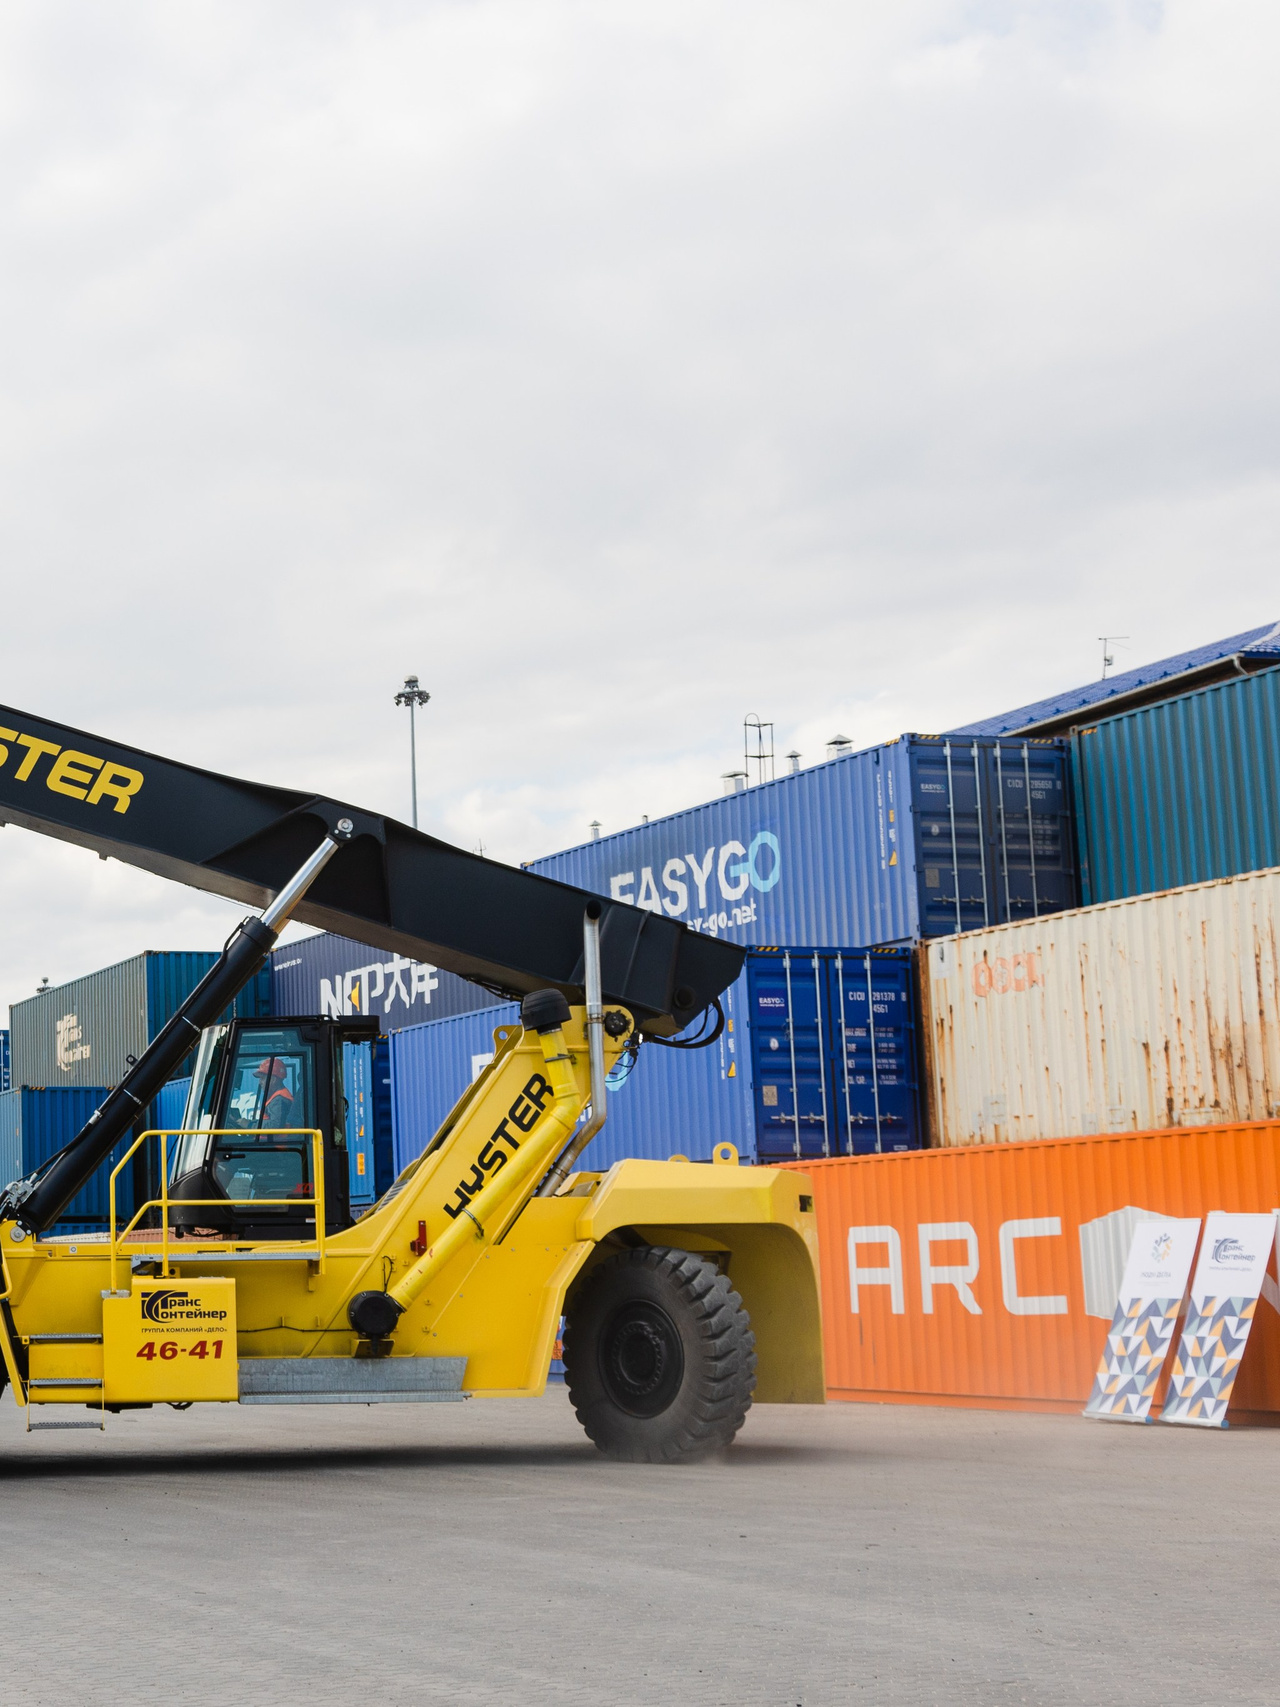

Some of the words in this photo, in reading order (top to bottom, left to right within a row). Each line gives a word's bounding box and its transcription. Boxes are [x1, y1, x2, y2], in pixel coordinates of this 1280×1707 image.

[610, 830, 780, 917] EASYGO
[848, 991, 865, 1001] CICU
[443, 1073, 554, 1219] HYSTER
[141, 1326, 165, 1334] ГРУППА
[166, 1325, 203, 1333] КОМПАНИЙ
[136, 1340, 223, 1361] 46-41
